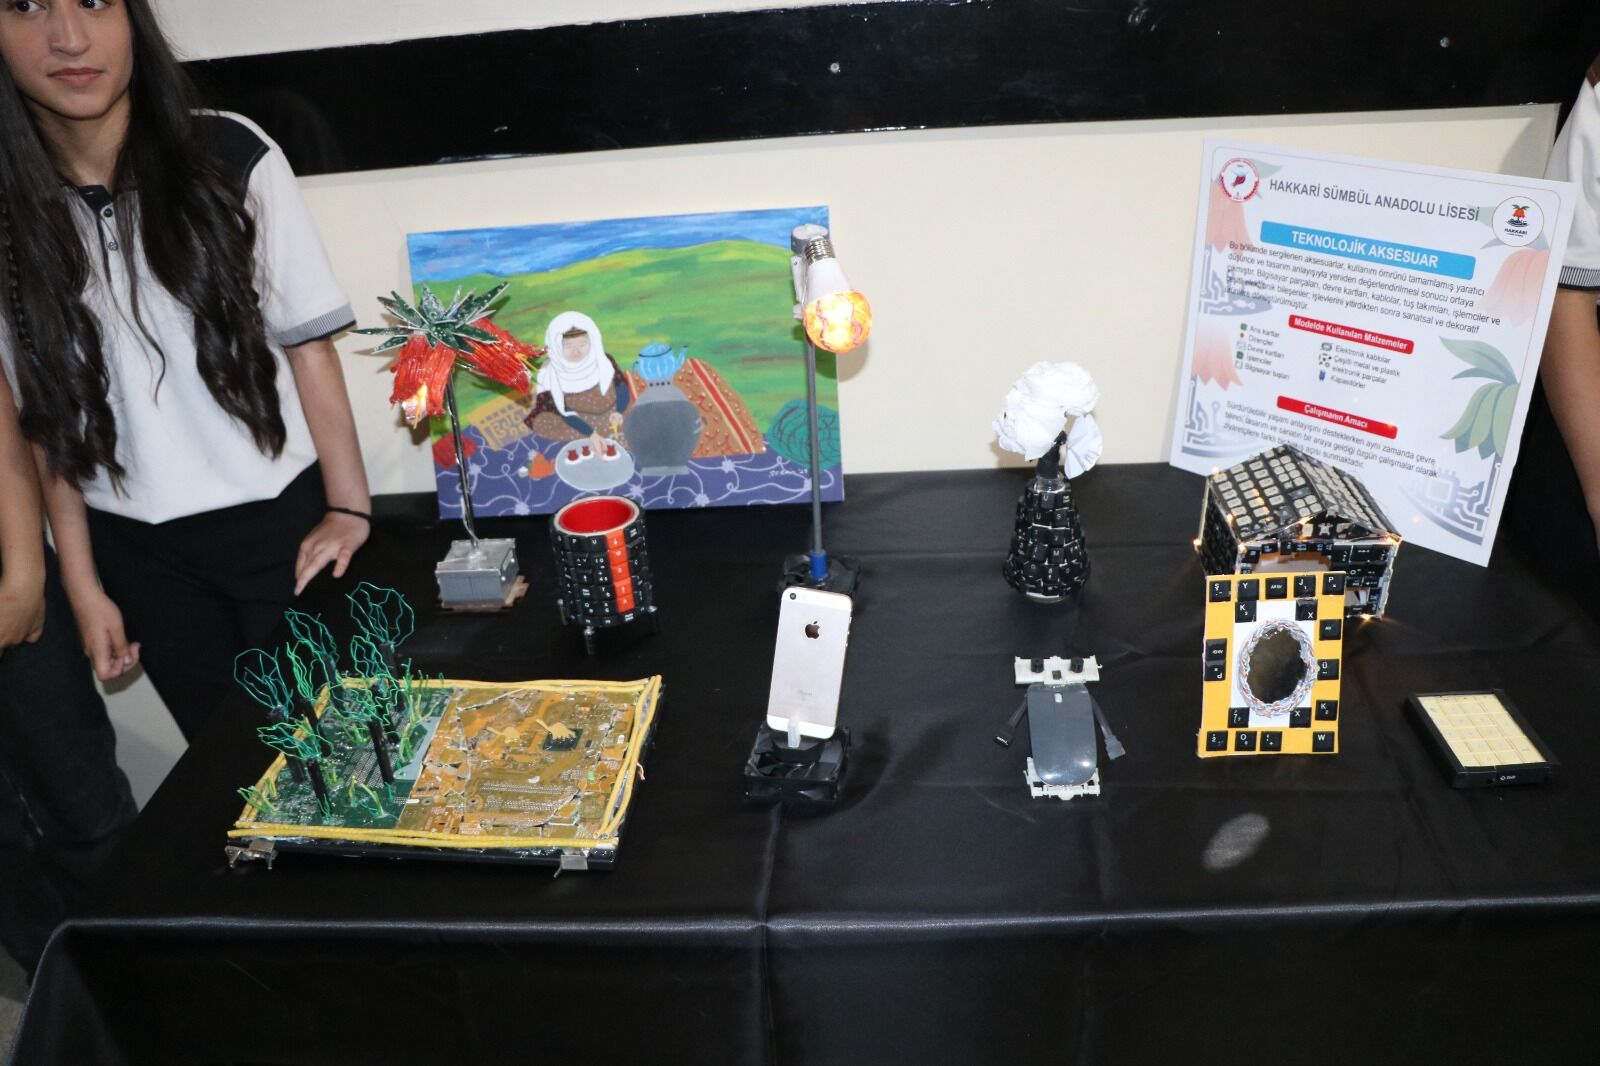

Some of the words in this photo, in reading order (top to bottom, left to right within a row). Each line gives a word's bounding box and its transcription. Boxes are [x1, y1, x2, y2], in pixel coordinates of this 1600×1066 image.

[1269, 179, 1320, 197] HAKKARİ
[1322, 185, 1370, 205] SÜMBÜL
[1374, 194, 1435, 214] ANADOLU
[1438, 202, 1480, 221] LİSESİ
[1292, 230, 1366, 255] TEKNOLOJİK
[1368, 244, 1438, 268] AKSESUAR
[1239, 242, 1267, 254] bölümde
[1268, 250, 1302, 262] sergilenen
[1347, 263, 1377, 275] kullanım
[1378, 268, 1406, 281] ömrünü
[1408, 274, 1454, 292] tamamlamış
[1456, 284, 1485, 296] yaratıcı
[1266, 260, 1290, 270] tasarım
[1329, 273, 1356, 284] yeniden
[1358, 277, 1418, 296] değerlendirilmesi
[1420, 290, 1448, 302] sonucu
[1450, 296, 1474, 308] ortaya
[1256, 269, 1288, 282] Bilgisayar
[1322, 283, 1342, 293] devre
[1403, 299, 1414, 309] tuş
[1452, 310, 1489, 323] işlemciler
[1294, 318, 1324, 331] Modelde
[1326, 324, 1363, 339] Kullanılan
[1364, 333, 1407, 349] Malzemeler
[1380, 307, 1400, 317] sonra
[1402, 312, 1433, 324] sanatsal
[1445, 320, 1479, 334] dekoratif
[1335, 345, 1364, 358] Elektronik
[1366, 352, 1390, 364] kablolar
[1353, 361, 1370, 369] metal
[1380, 367, 1400, 376] plastik
[1304, 404, 1343, 422] Çalışmanın
[1344, 415, 1368, 428] Amacı
[1313, 438, 1331, 448] araya
[1356, 448, 1377, 460] özgün
[1378, 456, 1414, 471] çalışmalar
[1416, 467, 1437, 477] olarak
[1322, 428, 1364, 444] desteklerken
[1365, 440, 1380, 450] aynı
[1382, 445, 1414, 459] zamanda
[1416, 454, 1435, 466] çevre
